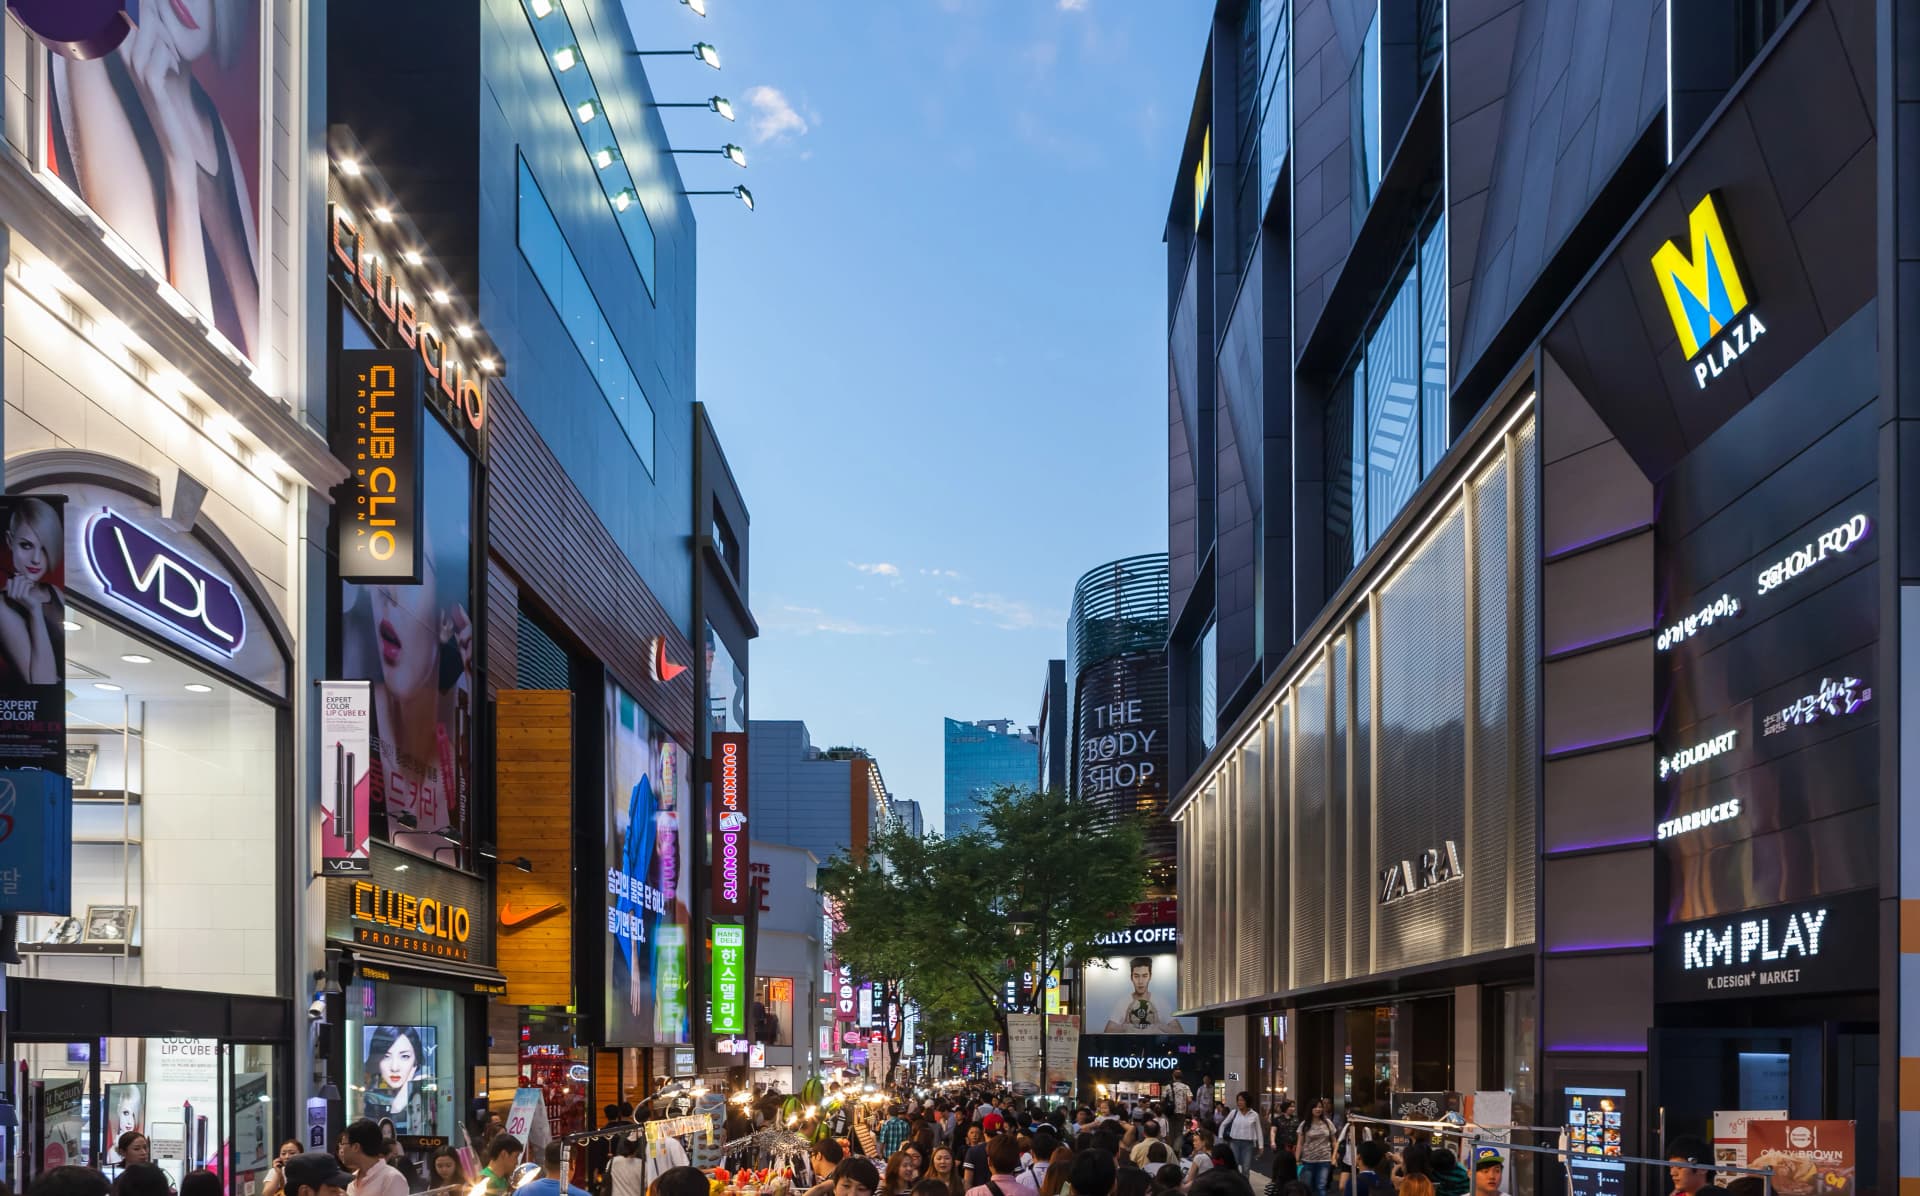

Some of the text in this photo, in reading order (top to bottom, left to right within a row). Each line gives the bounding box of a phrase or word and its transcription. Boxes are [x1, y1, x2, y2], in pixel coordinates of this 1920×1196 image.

[1651, 193, 1748, 361] M
[1694, 313, 1767, 389] PLAZA
[1757, 514, 1866, 595] SCHOOL FOOD
[113, 525, 235, 642] VDL
[1093, 699, 1143, 729] THE
[1087, 729, 1157, 762] BODY
[1680, 730, 1737, 769] DUDART
[1089, 762, 1154, 792] SHOP
[723, 743, 737, 900] DUNKIN' DONUTS
[1657, 798, 1740, 840] STARBUCKS
[329, 860, 363, 870] VDL
[750, 863, 769, 873] STE
[1380, 840, 1463, 904] ZARA
[0, 867, 22, 896] 달
[361, 930, 468, 960] PROFESSIONAL
[1086, 927, 1176, 945] OLLYS COFFE
[1684, 909, 1827, 970] KM PLAY
[720, 948, 738, 1017] 한스델리
[1759, 968, 1800, 985] MARKET
[162, 1045, 178, 1055] LIP
[1088, 1056, 1109, 1068] THE
[1112, 1056, 1144, 1069] BODY
[1146, 1057, 1178, 1070] SHOP
[509, 1117, 525, 1135] 20
[419, 1138, 441, 1146] CLIO
[1798, 1149, 1844, 1160] BROWN
